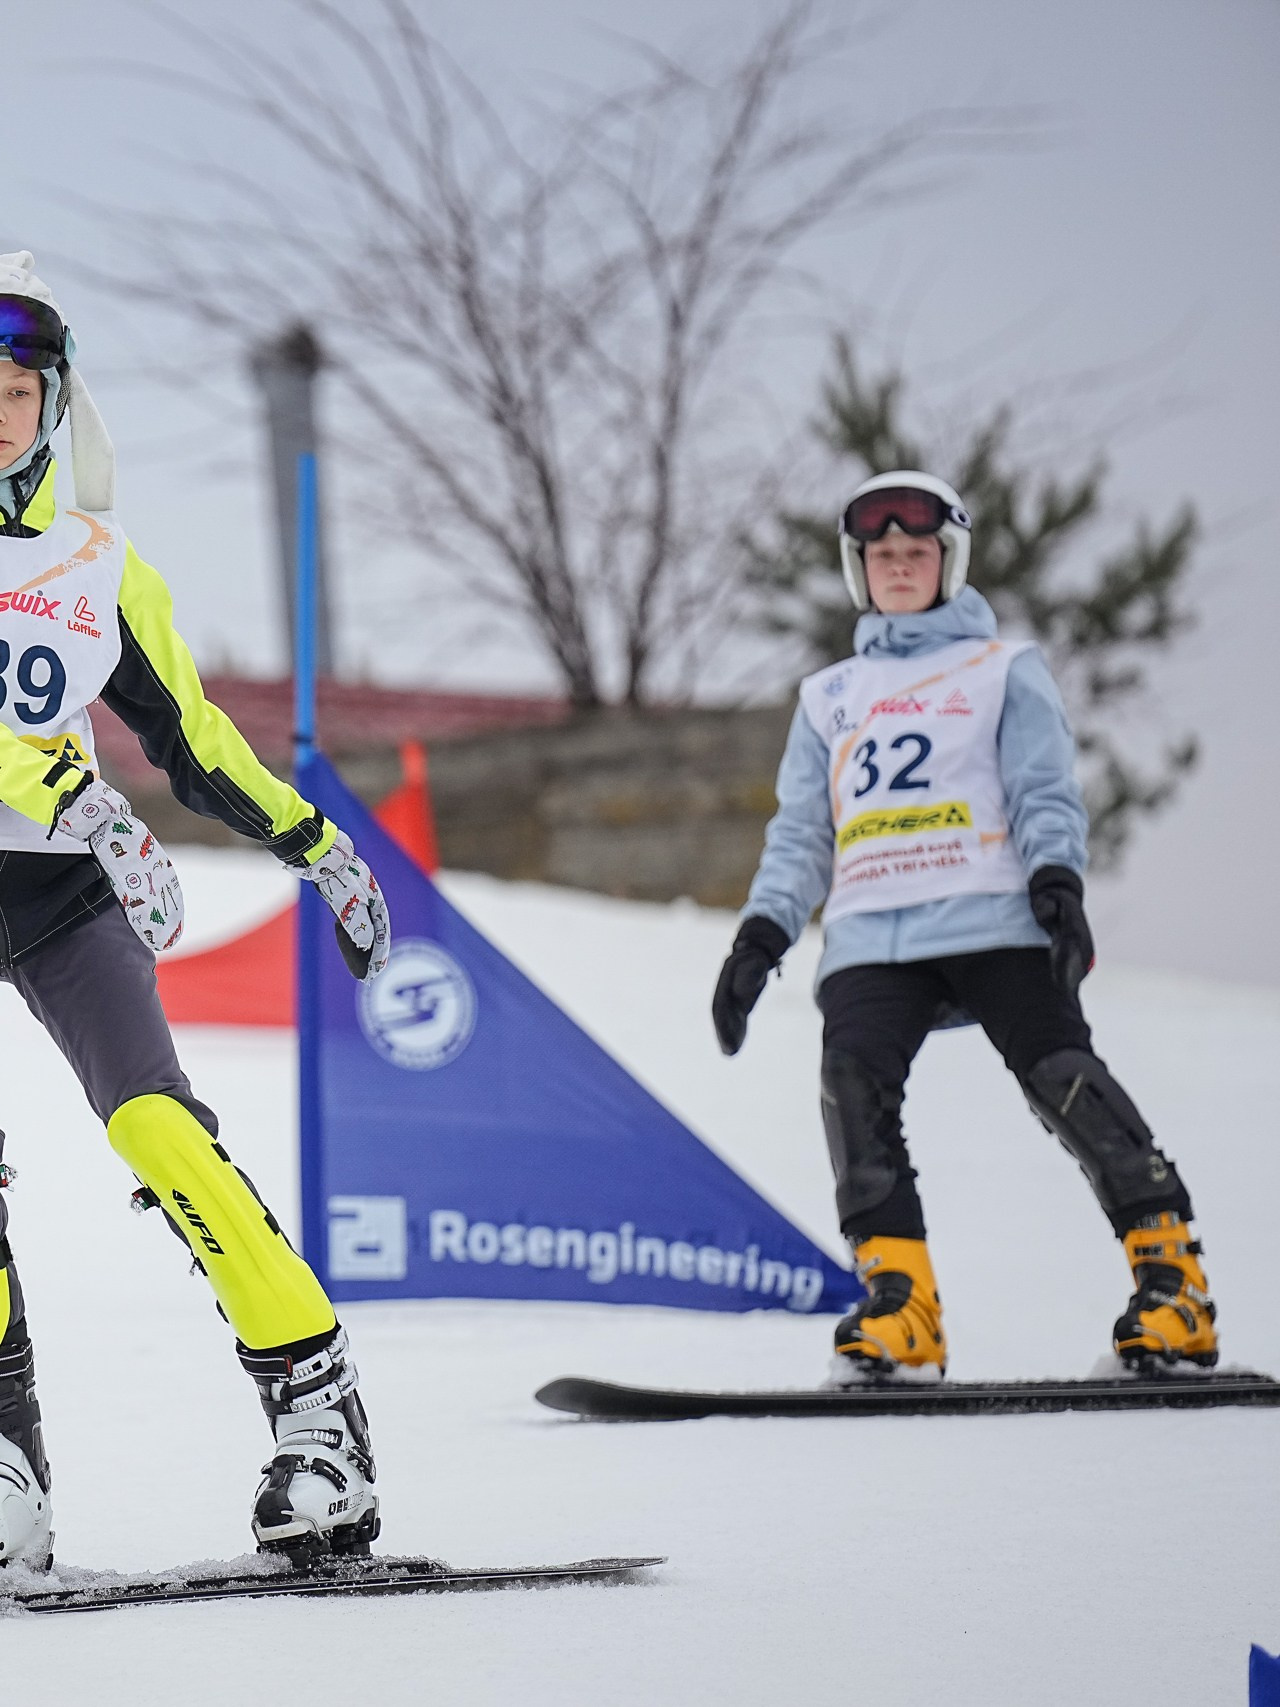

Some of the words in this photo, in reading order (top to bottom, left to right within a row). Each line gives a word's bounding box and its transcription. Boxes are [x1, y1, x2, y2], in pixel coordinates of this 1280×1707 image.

[853, 733, 933, 798] 32
[176, 1201, 225, 1255] UFO
[430, 1209, 824, 1313] Rosengineering
